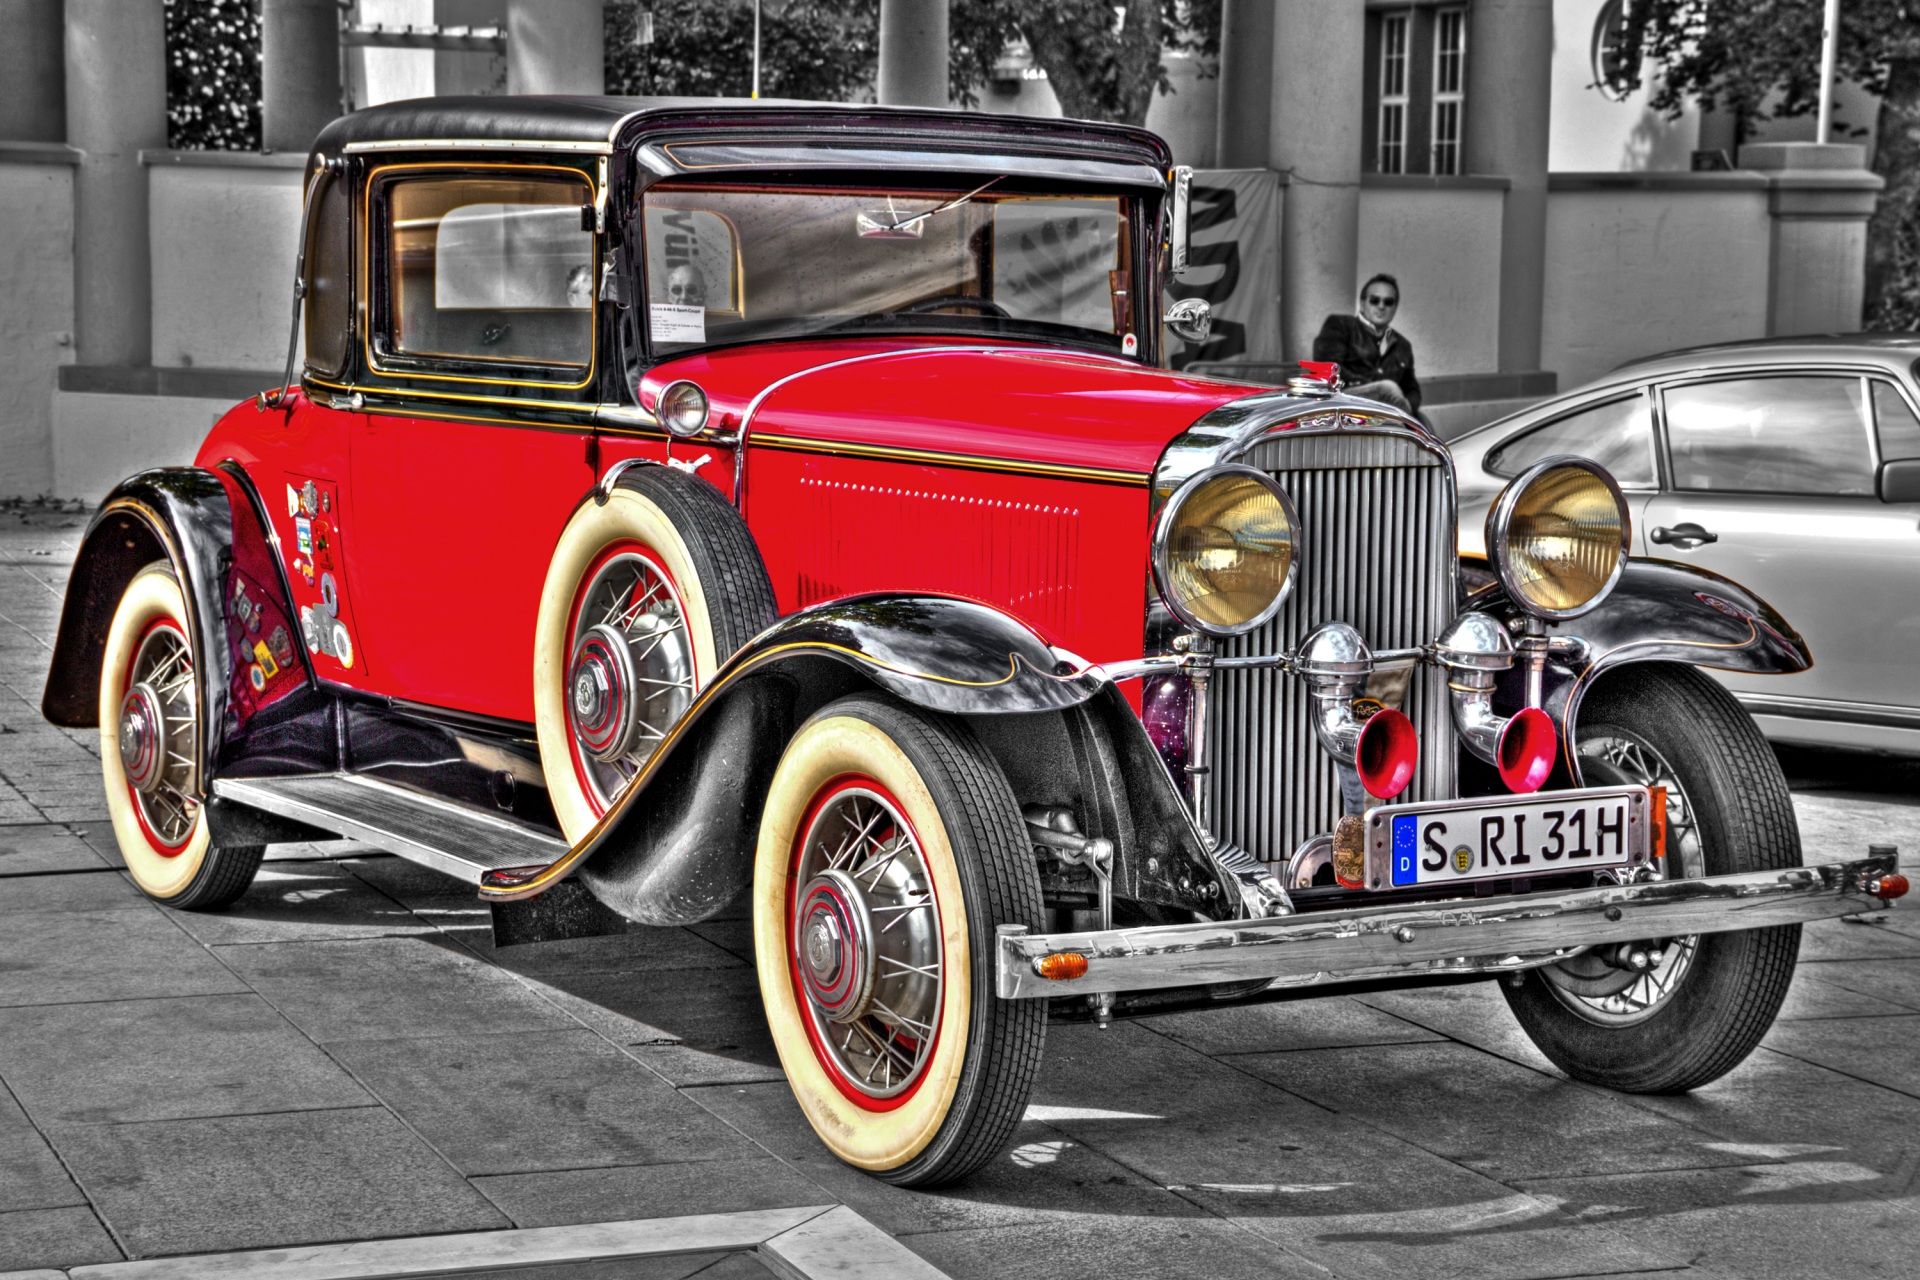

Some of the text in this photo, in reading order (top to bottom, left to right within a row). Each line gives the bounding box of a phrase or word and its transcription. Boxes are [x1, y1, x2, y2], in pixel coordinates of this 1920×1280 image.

[1421, 806, 1624, 872] S RI 31H
[1400, 857, 1410, 872] D
